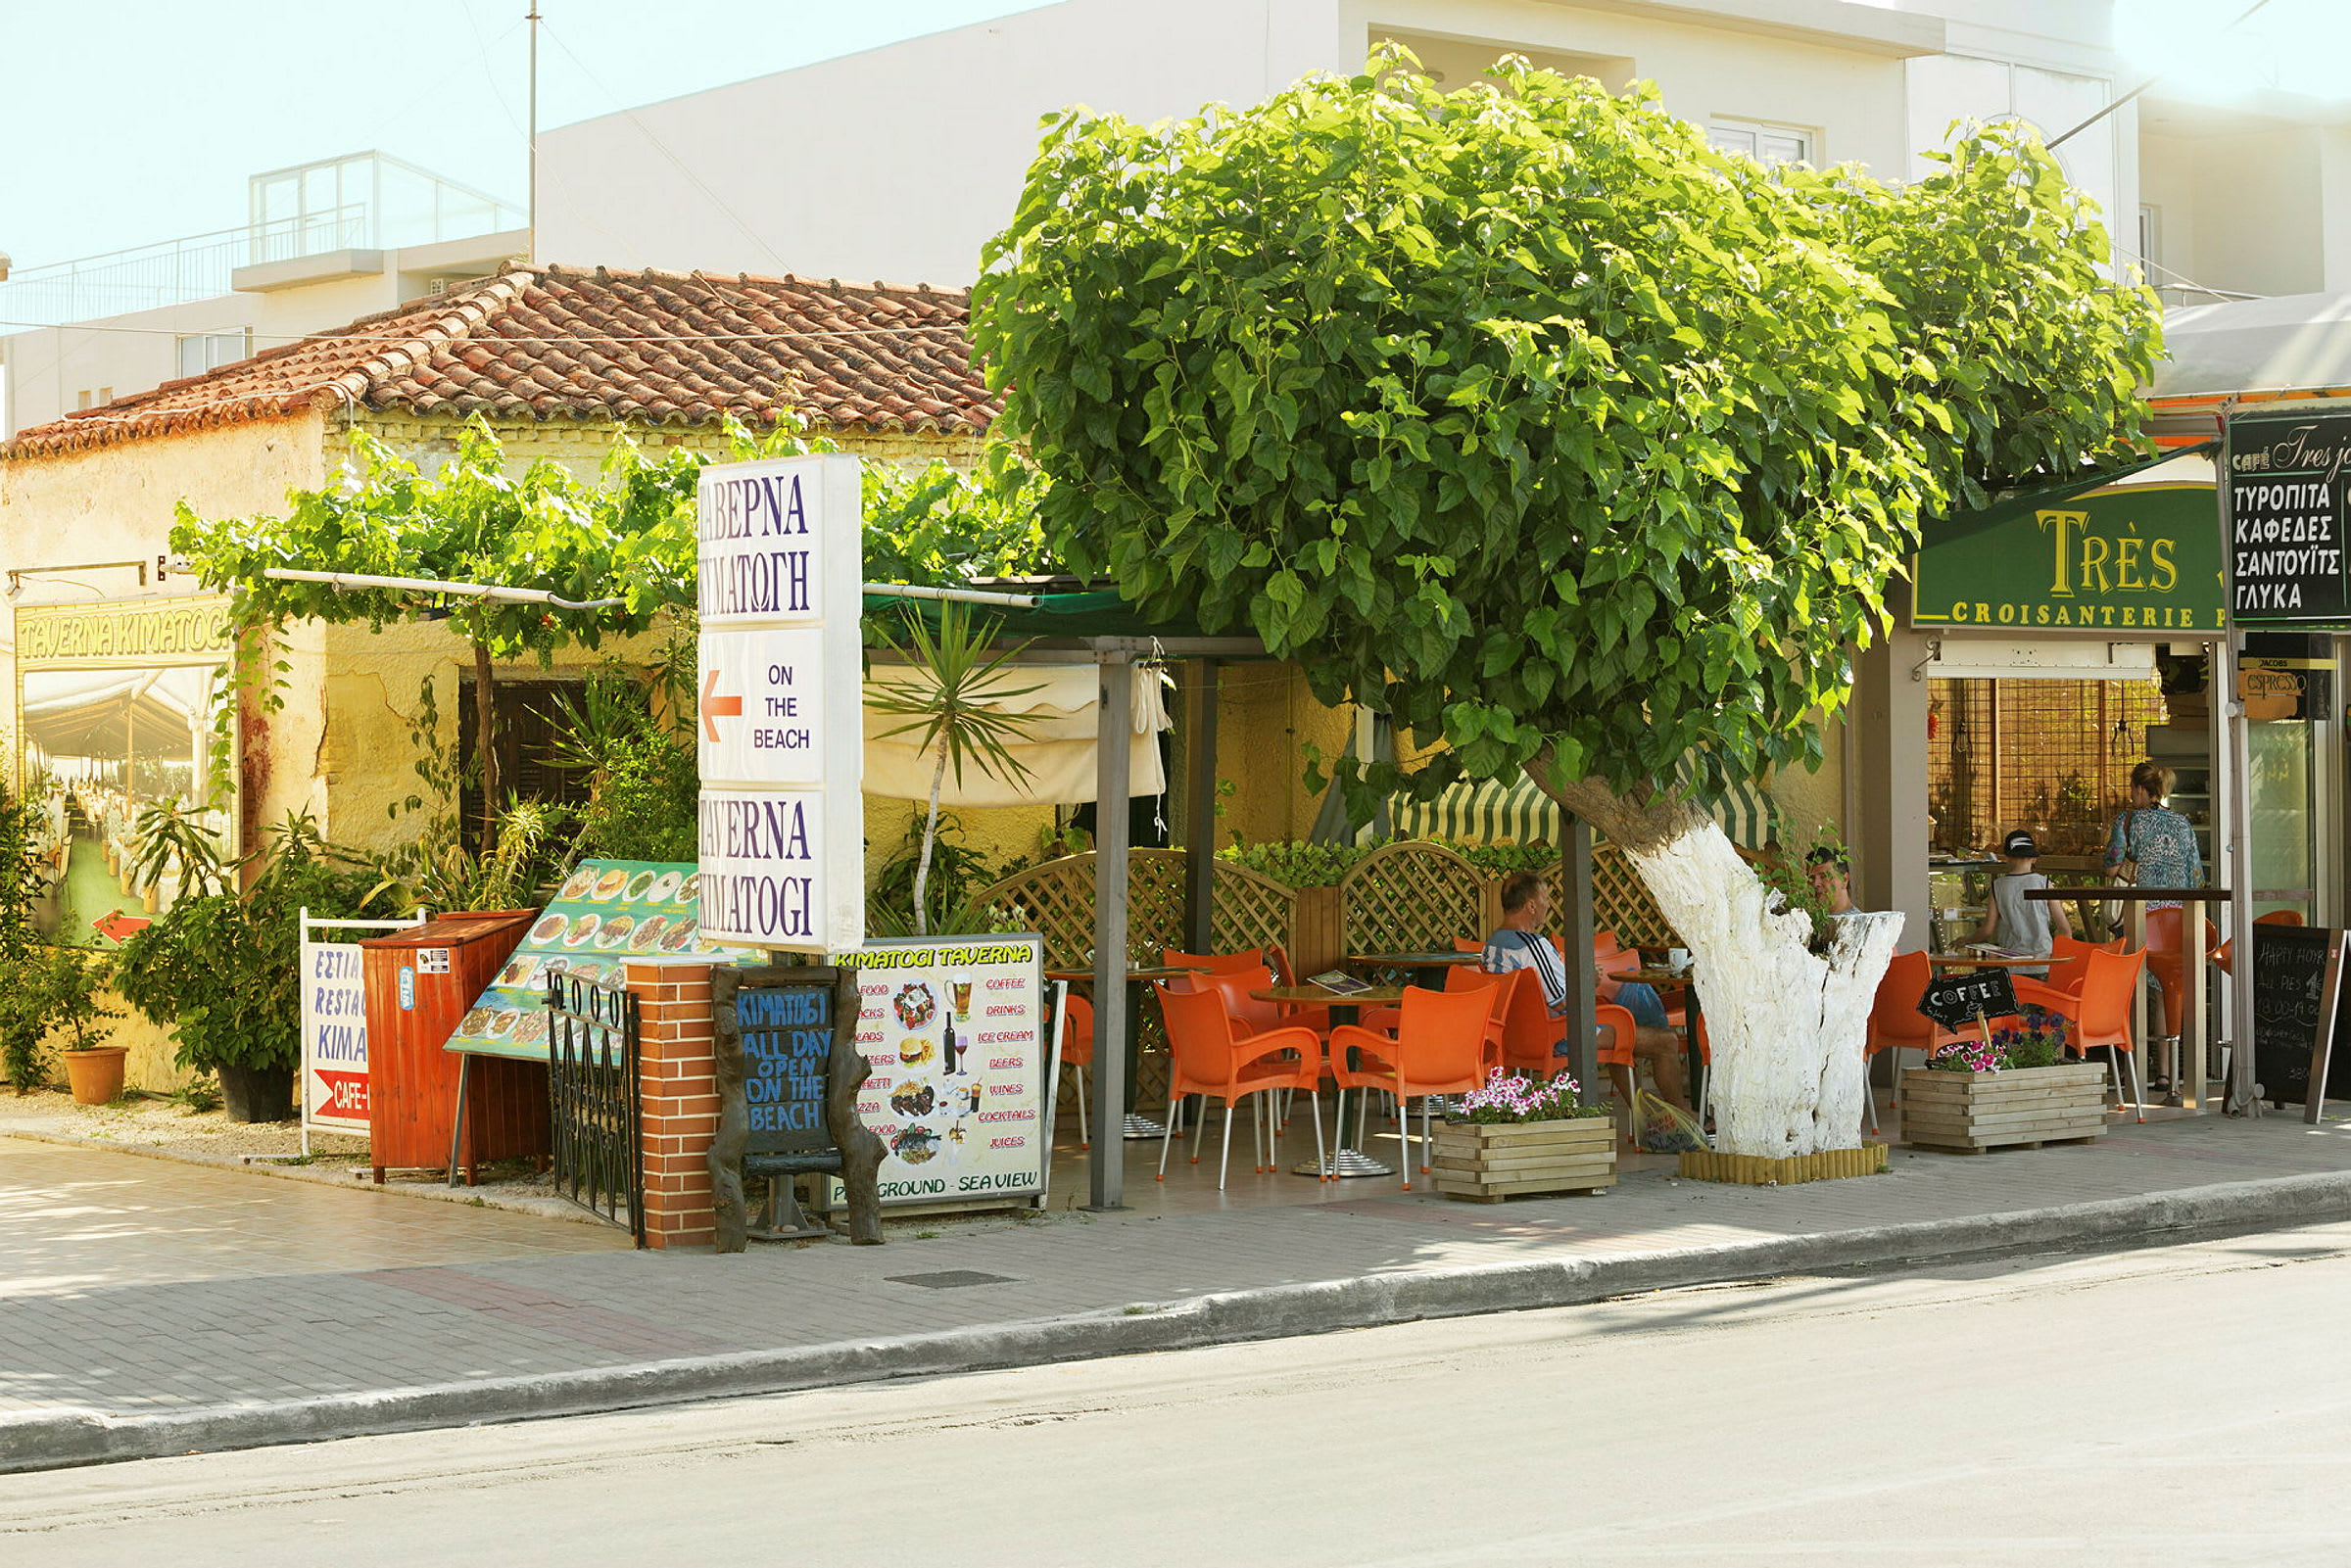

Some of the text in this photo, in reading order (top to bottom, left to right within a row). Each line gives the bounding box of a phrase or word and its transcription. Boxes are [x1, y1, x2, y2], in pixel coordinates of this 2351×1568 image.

[698, 473, 809, 543] ΤΑΒΕΡΝΑ
[2234, 483, 2330, 511] ΤΥΡΟΠΙΤΑ
[2235, 515, 2332, 544] ΚΑΦΕΔΕΣ
[2235, 545, 2340, 577] ΣΑΝΤΟΥΪΤΣ
[2235, 583, 2302, 610] ΓΛΥΚΑ
[1951, 600, 2193, 628] CROISANTERIE
[23, 614, 115, 659] TAVERNA
[768, 665, 792, 686] ON
[765, 697, 797, 717] THE
[753, 729, 809, 748] BEACH
[699, 799, 812, 860] TAVERNA
[698, 873, 813, 936] KIMATOGI
[315, 950, 363, 979] ΕΣΤΙΑ
[835, 944, 1033, 970] KIMATOGI TAVERNA
[860, 984, 889, 996] FOOD
[985, 977, 1026, 990] COFFEE
[1930, 980, 2001, 1007] COFFEE
[986, 1004, 1026, 1017] DRINKS
[743, 1029, 832, 1060] ALL DAY
[854, 1031, 885, 1043] LADS
[978, 1029, 1034, 1043] ICE CREAM
[757, 1058, 816, 1077] OPEN
[988, 1057, 1024, 1069] BEERS
[744, 1076, 824, 1103] ON THE
[989, 1083, 1024, 1096] WINES
[749, 1101, 820, 1131] BEACH
[857, 1102, 881, 1114] ZZA
[978, 1109, 1036, 1123] COCKTAILS
[989, 1136, 1026, 1149] JUICES
[958, 1175, 991, 1191] SEA
[995, 1171, 1038, 1188] VIEW
